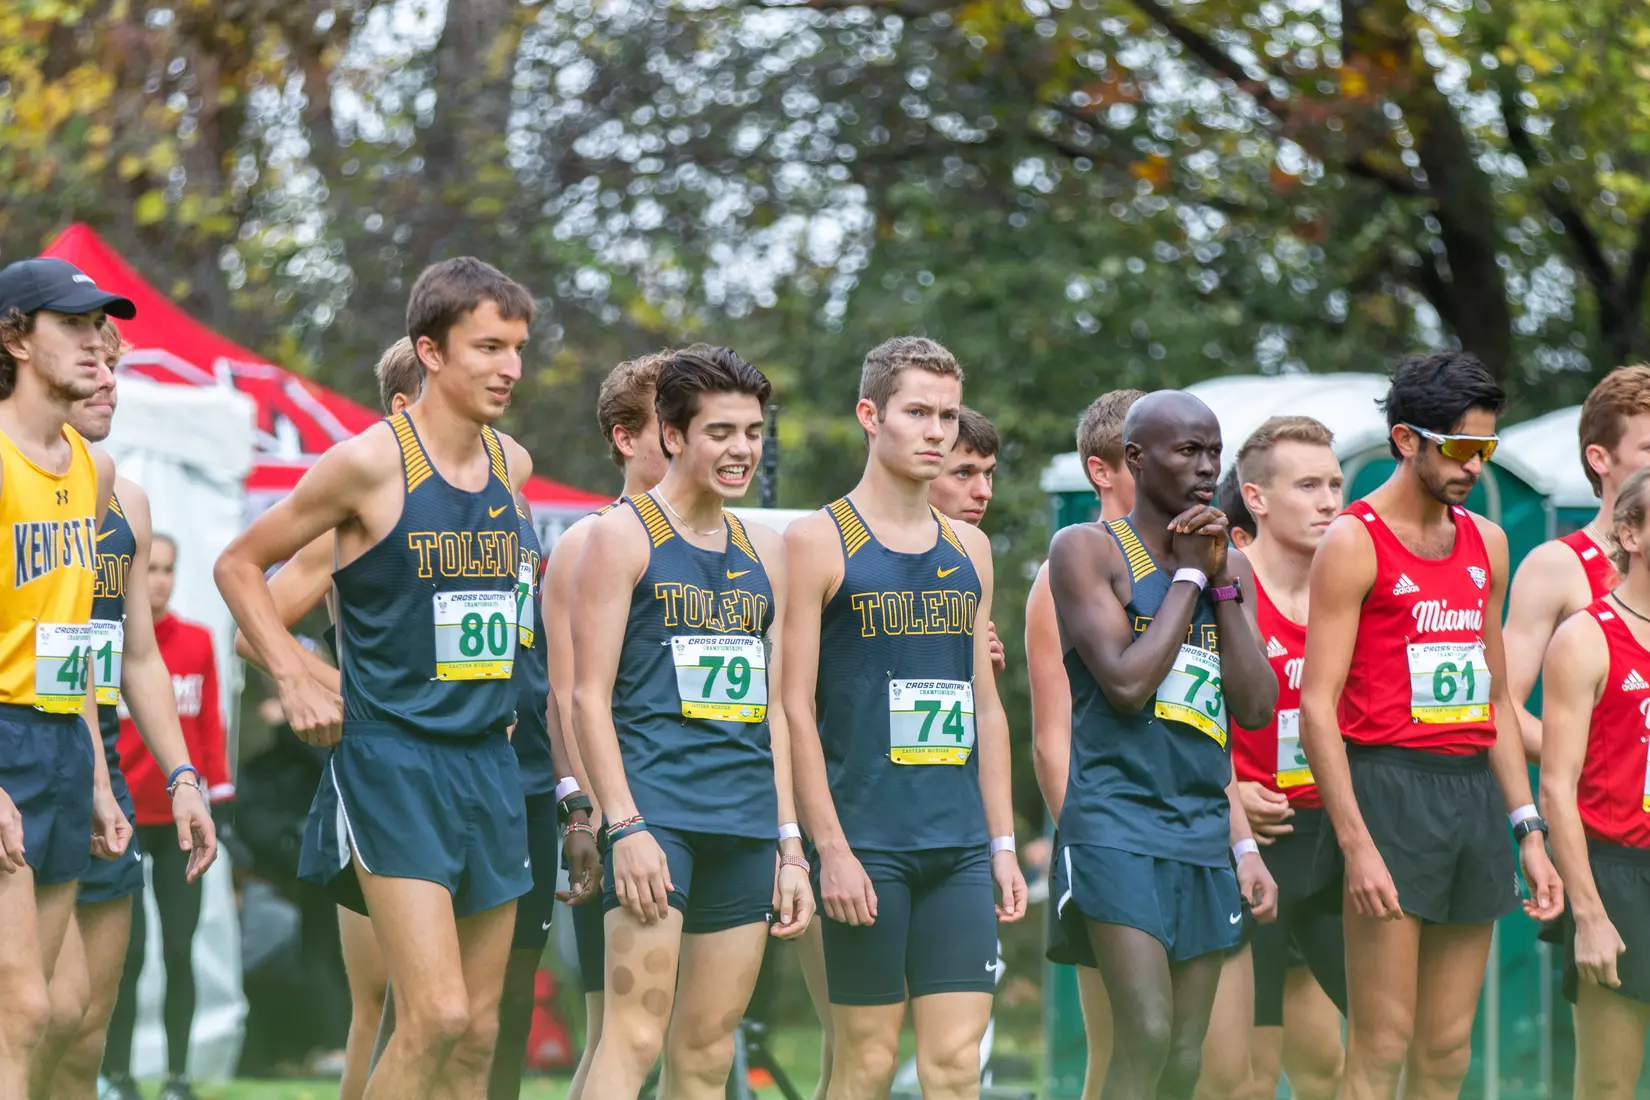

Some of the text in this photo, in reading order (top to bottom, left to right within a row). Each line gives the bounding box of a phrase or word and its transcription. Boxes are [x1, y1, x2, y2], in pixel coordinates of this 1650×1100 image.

[14, 521, 59, 590] KENT
[408, 531, 519, 578] TOLEDO
[451, 594, 507, 602] CROSS COUNTRY
[654, 582, 768, 633] TOLEDO
[1393, 584, 1420, 596] adidas
[55, 626, 79, 634] CROSS
[459, 612, 508, 657] 80
[851, 590, 977, 637] TOLEDO
[1411, 598, 1483, 633] Miami
[97, 640, 112, 682] 1
[718, 638, 754, 646] COUNTRY
[1180, 646, 1208, 660] CROSS
[699, 655, 751, 700] 79
[935, 682, 965, 690] COUNTRY
[1183, 663, 1223, 718] 73
[1432, 660, 1475, 703] 61
[753, 707, 761, 718] E
[914, 700, 964, 743] 74
